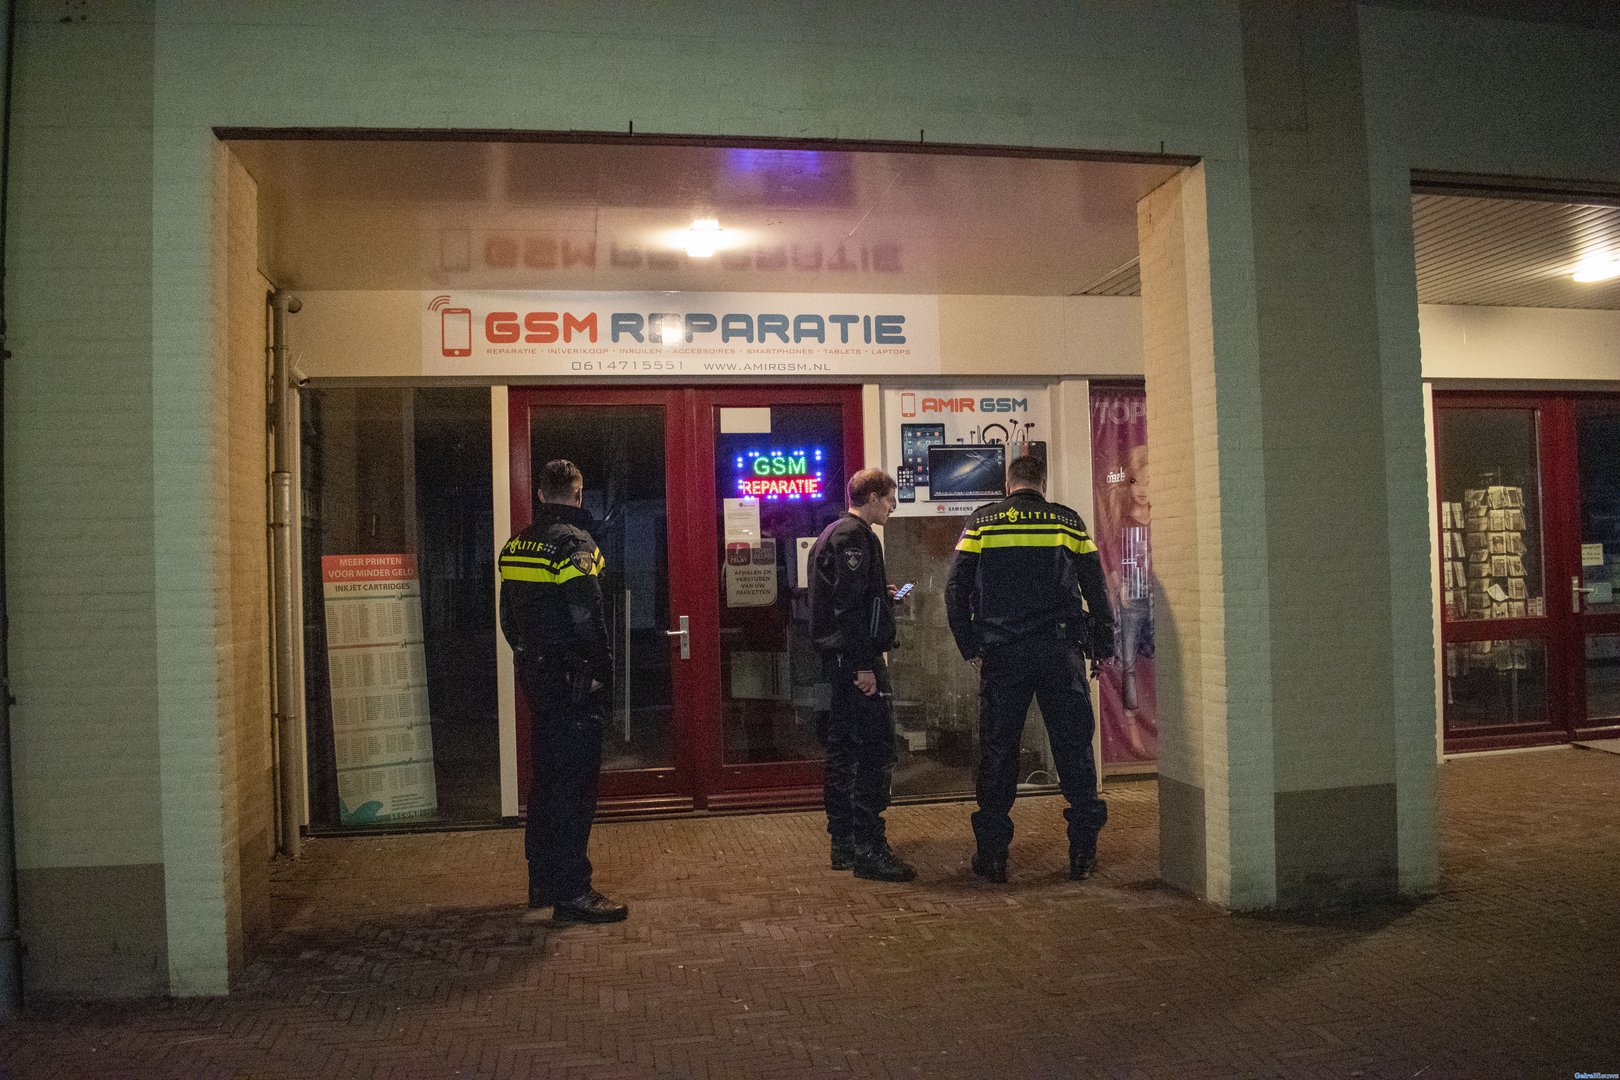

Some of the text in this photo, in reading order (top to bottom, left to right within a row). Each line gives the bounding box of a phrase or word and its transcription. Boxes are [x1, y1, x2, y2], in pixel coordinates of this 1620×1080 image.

[485, 311, 907, 345] GSM REPARATIE
[871, 348, 911, 356] LAPTOPS
[571, 360, 832, 371] 0614715551 WWW.AMIRGSM.NL
[921, 397, 1028, 413] AMIR GSM
[753, 456, 806, 475] GSM
[742, 479, 818, 495] REPARATIE
[339, 557, 402, 567] MEER PRINTEN
[328, 568, 414, 578] VOOR MINDER GELD
[335, 582, 411, 593] INKJET CARTRIDGES
